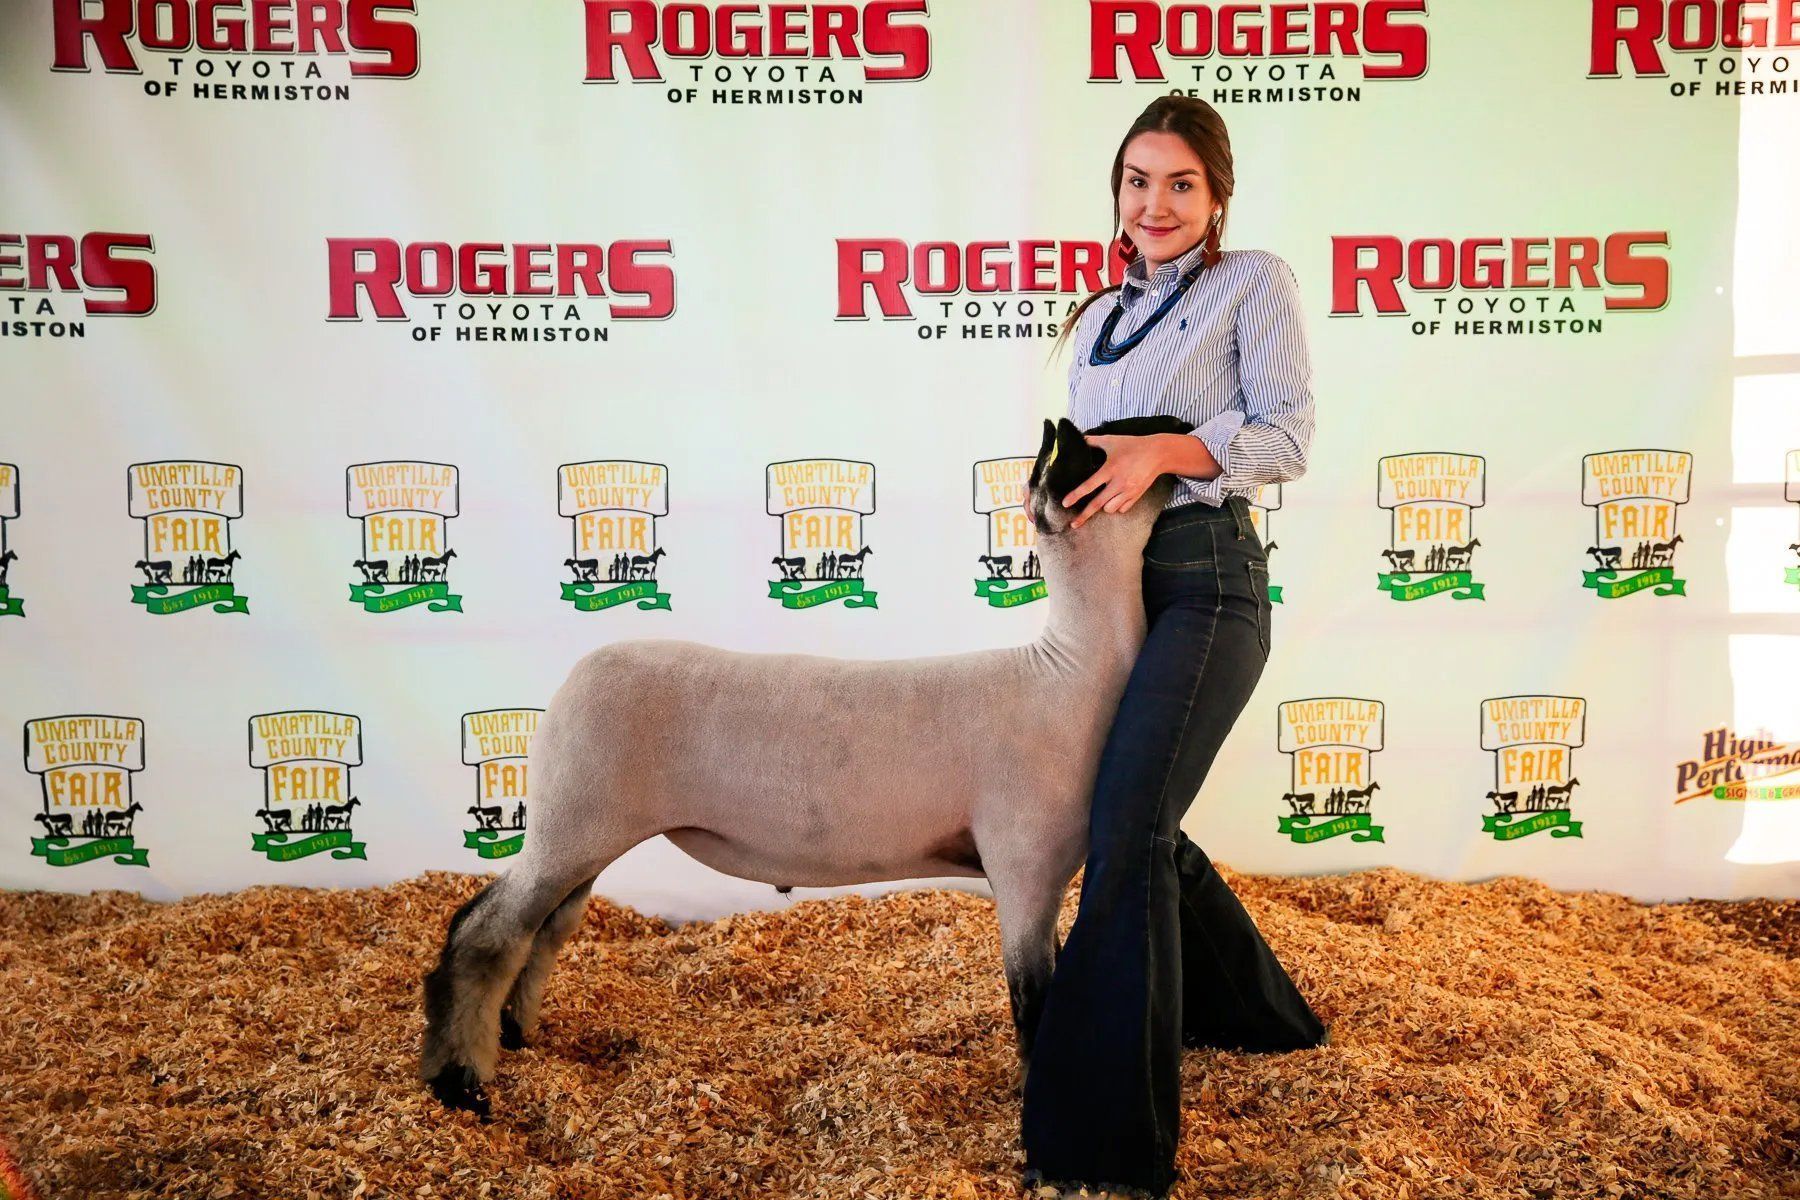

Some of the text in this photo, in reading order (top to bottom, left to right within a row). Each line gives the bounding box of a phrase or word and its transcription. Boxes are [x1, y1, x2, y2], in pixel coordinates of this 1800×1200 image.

[53, 0, 419, 79] ROGERS
[582, 0, 931, 83] ROGERS
[1087, 0, 1430, 82] ROGERS
[1587, 0, 1800, 77] ROGE
[168, 58, 322, 79] TOYOTA
[689, 65, 836, 83] TOYOTA
[1191, 64, 1336, 82] TOYOTA
[1693, 56, 1789, 75] TOYO
[143, 80, 350, 101] OF HERMISTON
[667, 88, 863, 105] OF HERMISTON
[1213, 87, 1361, 104] HERMISTON
[1670, 79, 1799, 97] OF HERMI
[0, 232, 157, 316] ERS
[326, 237, 677, 321] ROGERS
[1329, 231, 1671, 316] ROGERS
[432, 303, 581, 321] TOYOTA
[939, 300, 1077, 318] TOYOTA
[1433, 296, 1575, 314] TOYOTA
[1, 321, 85, 338] ISTON
[412, 326, 608, 342] OF HERMISTON
[917, 323, 1059, 340] OF HERMIS
[1411, 319, 1602, 336] OF HERMISTON
[137, 464, 235, 487] UMATILLA
[565, 464, 661, 487] UMATILLA
[774, 462, 868, 486] UMATILLA
[981, 460, 1034, 483] UMAT
[1386, 456, 1479, 479] UMATILLA
[1591, 453, 1687, 476] UMATILLA
[354, 464, 452, 488] UMATILLA
[1600, 476, 1677, 497] COUNTY
[147, 488, 225, 509] COUNTY
[364, 488, 444, 509] COUNTY
[575, 487, 653, 509] COUNTY
[784, 486, 859, 507] COUNTY
[990, 484, 1023, 505] COU
[1395, 479, 1470, 500] COUNTY
[788, 513, 856, 552] FAIR
[994, 511, 1038, 547] FA
[1399, 506, 1466, 545] FAIR
[1604, 504, 1669, 541] FAIR
[152, 516, 225, 556] FAIR
[369, 515, 441, 556] FAIR
[580, 514, 650, 555] FAIR
[1433, 576, 1458, 590] 1912
[1638, 573, 1661, 587] 1912
[193, 588, 220, 603] 1912
[409, 588, 435, 602] 1912
[618, 587, 644, 600] 1912
[825, 585, 850, 598] 1912
[1287, 701, 1378, 723] UMATILLA
[1489, 699, 1581, 721] UMATILLA
[33, 718, 137, 743] UMATILLA
[257, 714, 354, 738] UMATILLA
[470, 712, 538, 735] UMATI
[1294, 724, 1368, 744] COUNTY
[1498, 721, 1571, 742] COUNTY
[44, 742, 127, 764] COUNTY
[267, 737, 346, 759] COUNTY
[479, 735, 532, 756] COUN
[1299, 751, 1365, 788] FAIR
[1503, 748, 1566, 784] FAIR
[48, 770, 126, 809] FAIR
[271, 766, 345, 804] FAIR
[483, 762, 528, 798] FAI
[1332, 819, 1358, 833] 1912
[1533, 815, 1557, 829] 1912
[311, 837, 337, 850] 1912
